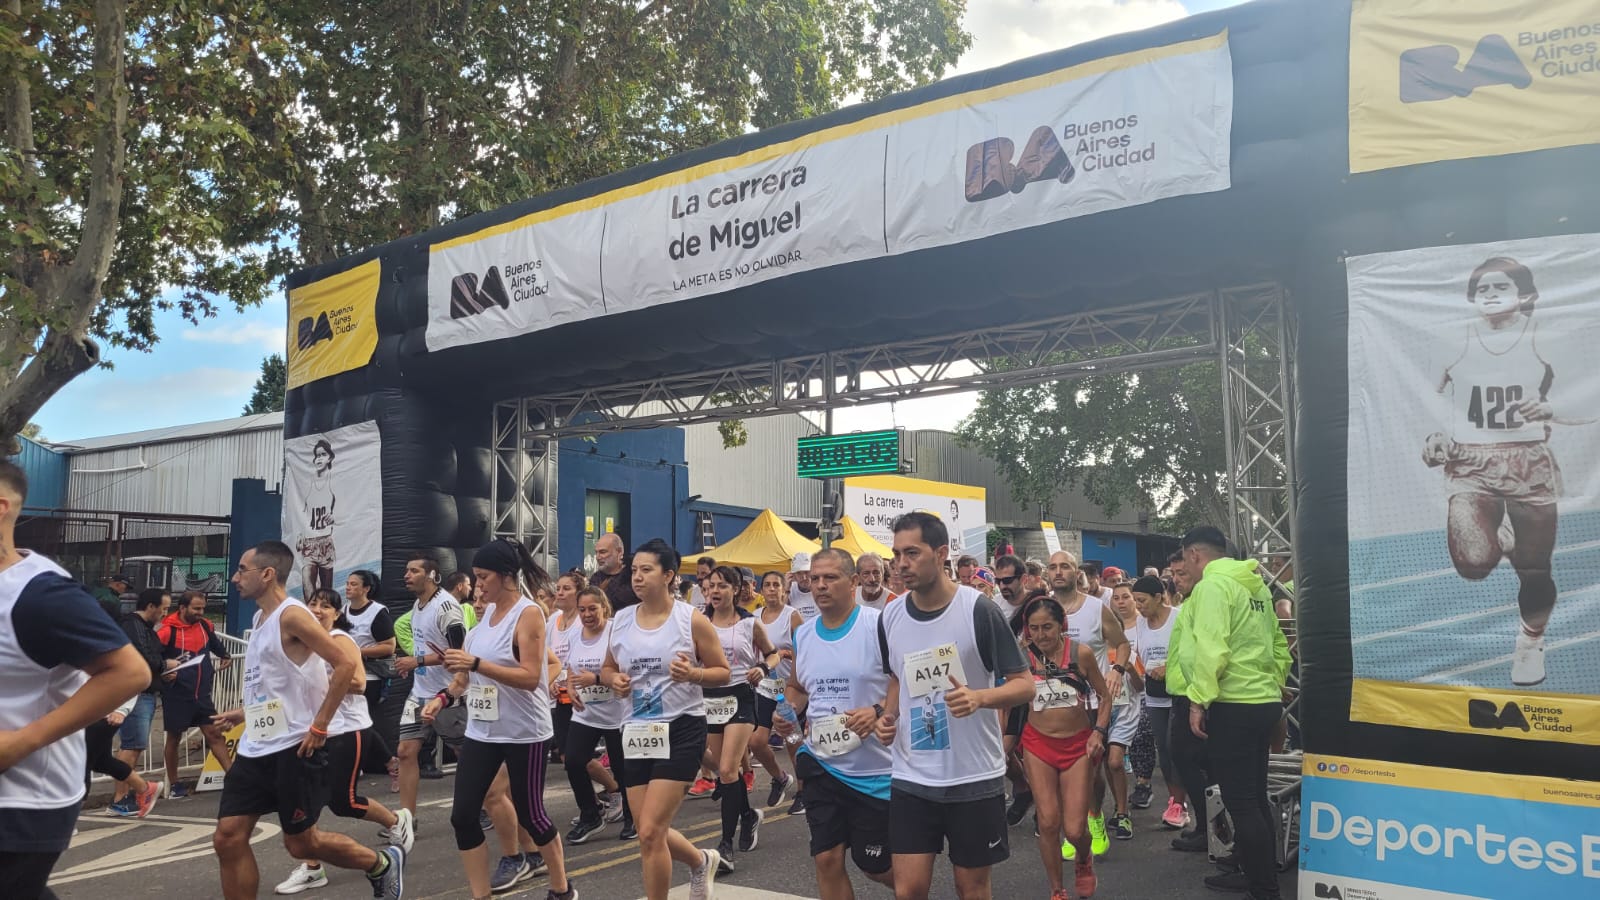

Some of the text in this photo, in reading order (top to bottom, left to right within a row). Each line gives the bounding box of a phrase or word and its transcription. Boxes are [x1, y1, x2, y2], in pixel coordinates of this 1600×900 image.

[1518, 23, 1600, 46] Buenos
[1532, 41, 1597, 62] Aires
[1541, 55, 1600, 78] Ciud
[1063, 114, 1138, 140] Buenos
[1076, 133, 1131, 156] Aires
[1082, 143, 1155, 172] Ciudad
[671, 165, 807, 219] La carrera
[668, 201, 801, 261] de Miguel
[505, 259, 542, 278] Buenos
[672, 249, 802, 291] LA META ES NO OLVIDAR
[511, 273, 536, 290] Aires
[514, 280, 549, 302] Ciudad
[1468, 384, 1524, 430] 422
[864, 492, 904, 509] La carrera
[310, 505, 327, 530] 422
[864, 512, 875, 525] de
[938, 646, 953, 657] 8K
[915, 662, 950, 682] A147
[1037, 691, 1070, 703] A729
[1523, 704, 1563, 715] Buenos
[1530, 713, 1560, 723] Aires
[254, 715, 275, 729] A60
[1534, 722, 1572, 733] Ciudad
[628, 736, 664, 748] A1291
[819, 729, 850, 745] A146
